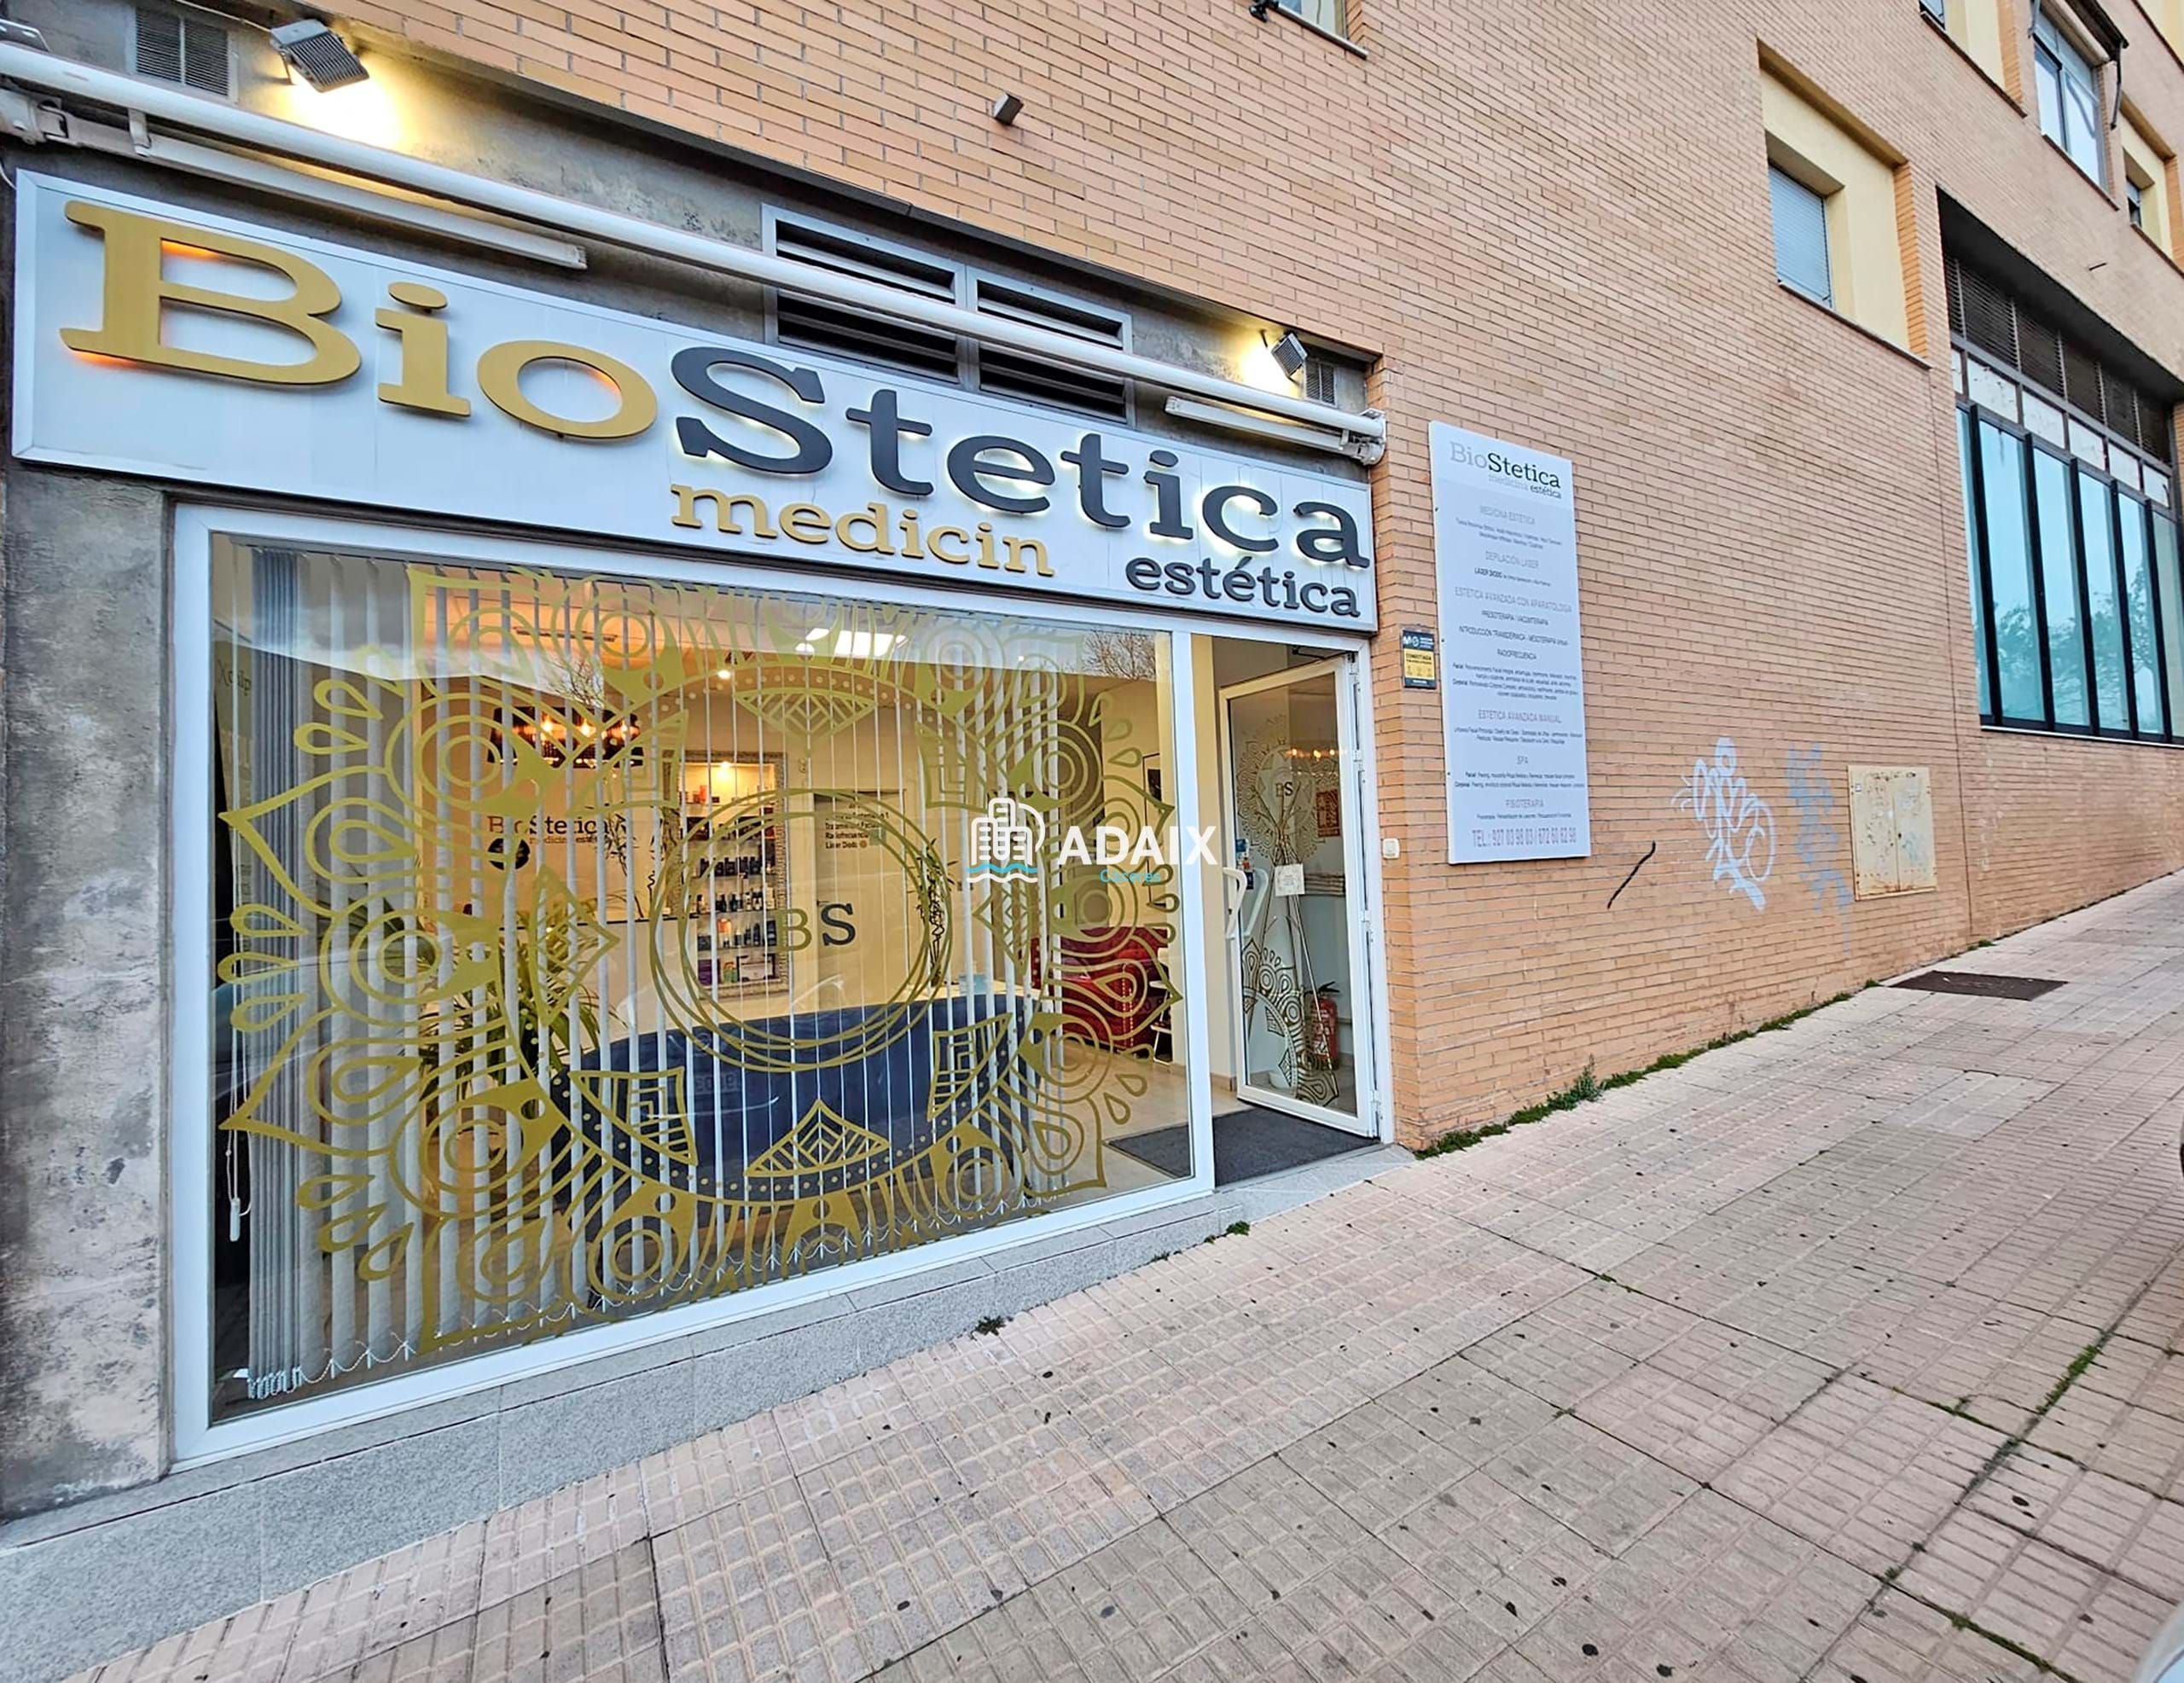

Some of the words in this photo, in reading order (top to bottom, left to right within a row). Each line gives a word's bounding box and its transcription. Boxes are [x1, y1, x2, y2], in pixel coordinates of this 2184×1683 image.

[59, 200, 1370, 568] BioStetica
[1449, 441, 1561, 489] BioStetica
[670, 483, 1054, 577] medicin
[1125, 556, 1361, 618] estética
